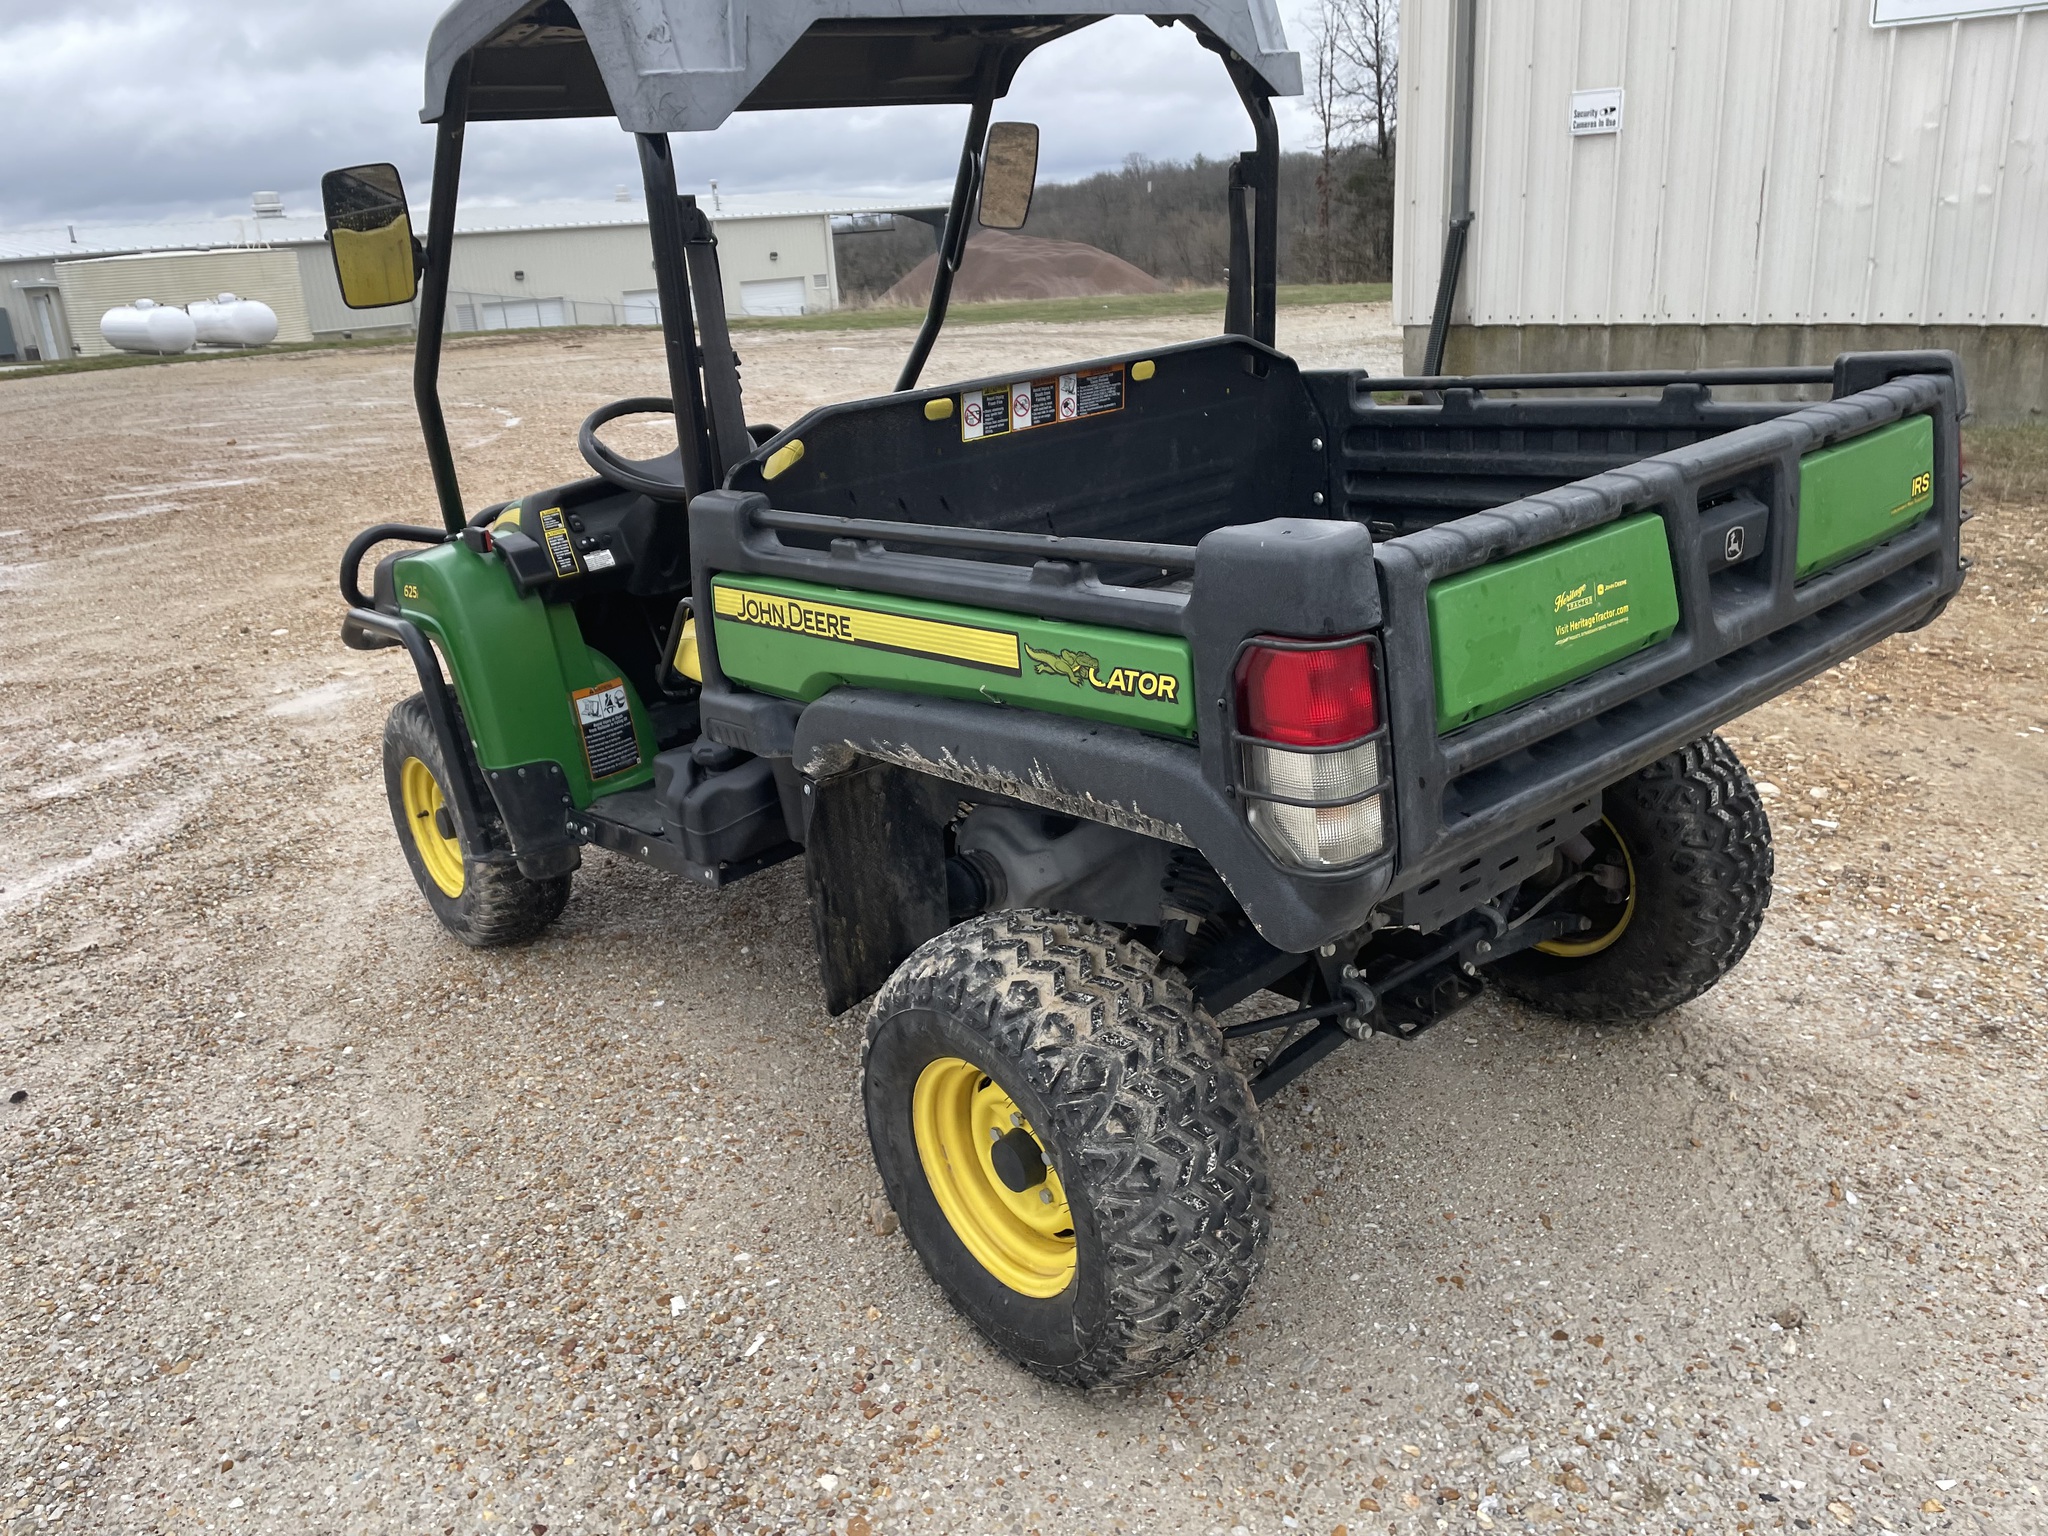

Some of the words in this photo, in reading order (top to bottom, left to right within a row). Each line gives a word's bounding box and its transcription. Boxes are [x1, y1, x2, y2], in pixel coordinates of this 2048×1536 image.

[1573, 109, 1597, 119] Security
[1573, 121, 1597, 129] Cameras
[1605, 118, 1616, 127] Use
[1911, 471, 1930, 497] IRS
[1554, 583, 1587, 613] Heritage
[1567, 596, 1592, 611] TRACTOR
[737, 594, 785, 625] JOHN
[788, 602, 853, 639] DEERE
[1555, 624, 1569, 636] Visit
[1570, 605, 1629, 628] HeritageTractor.com
